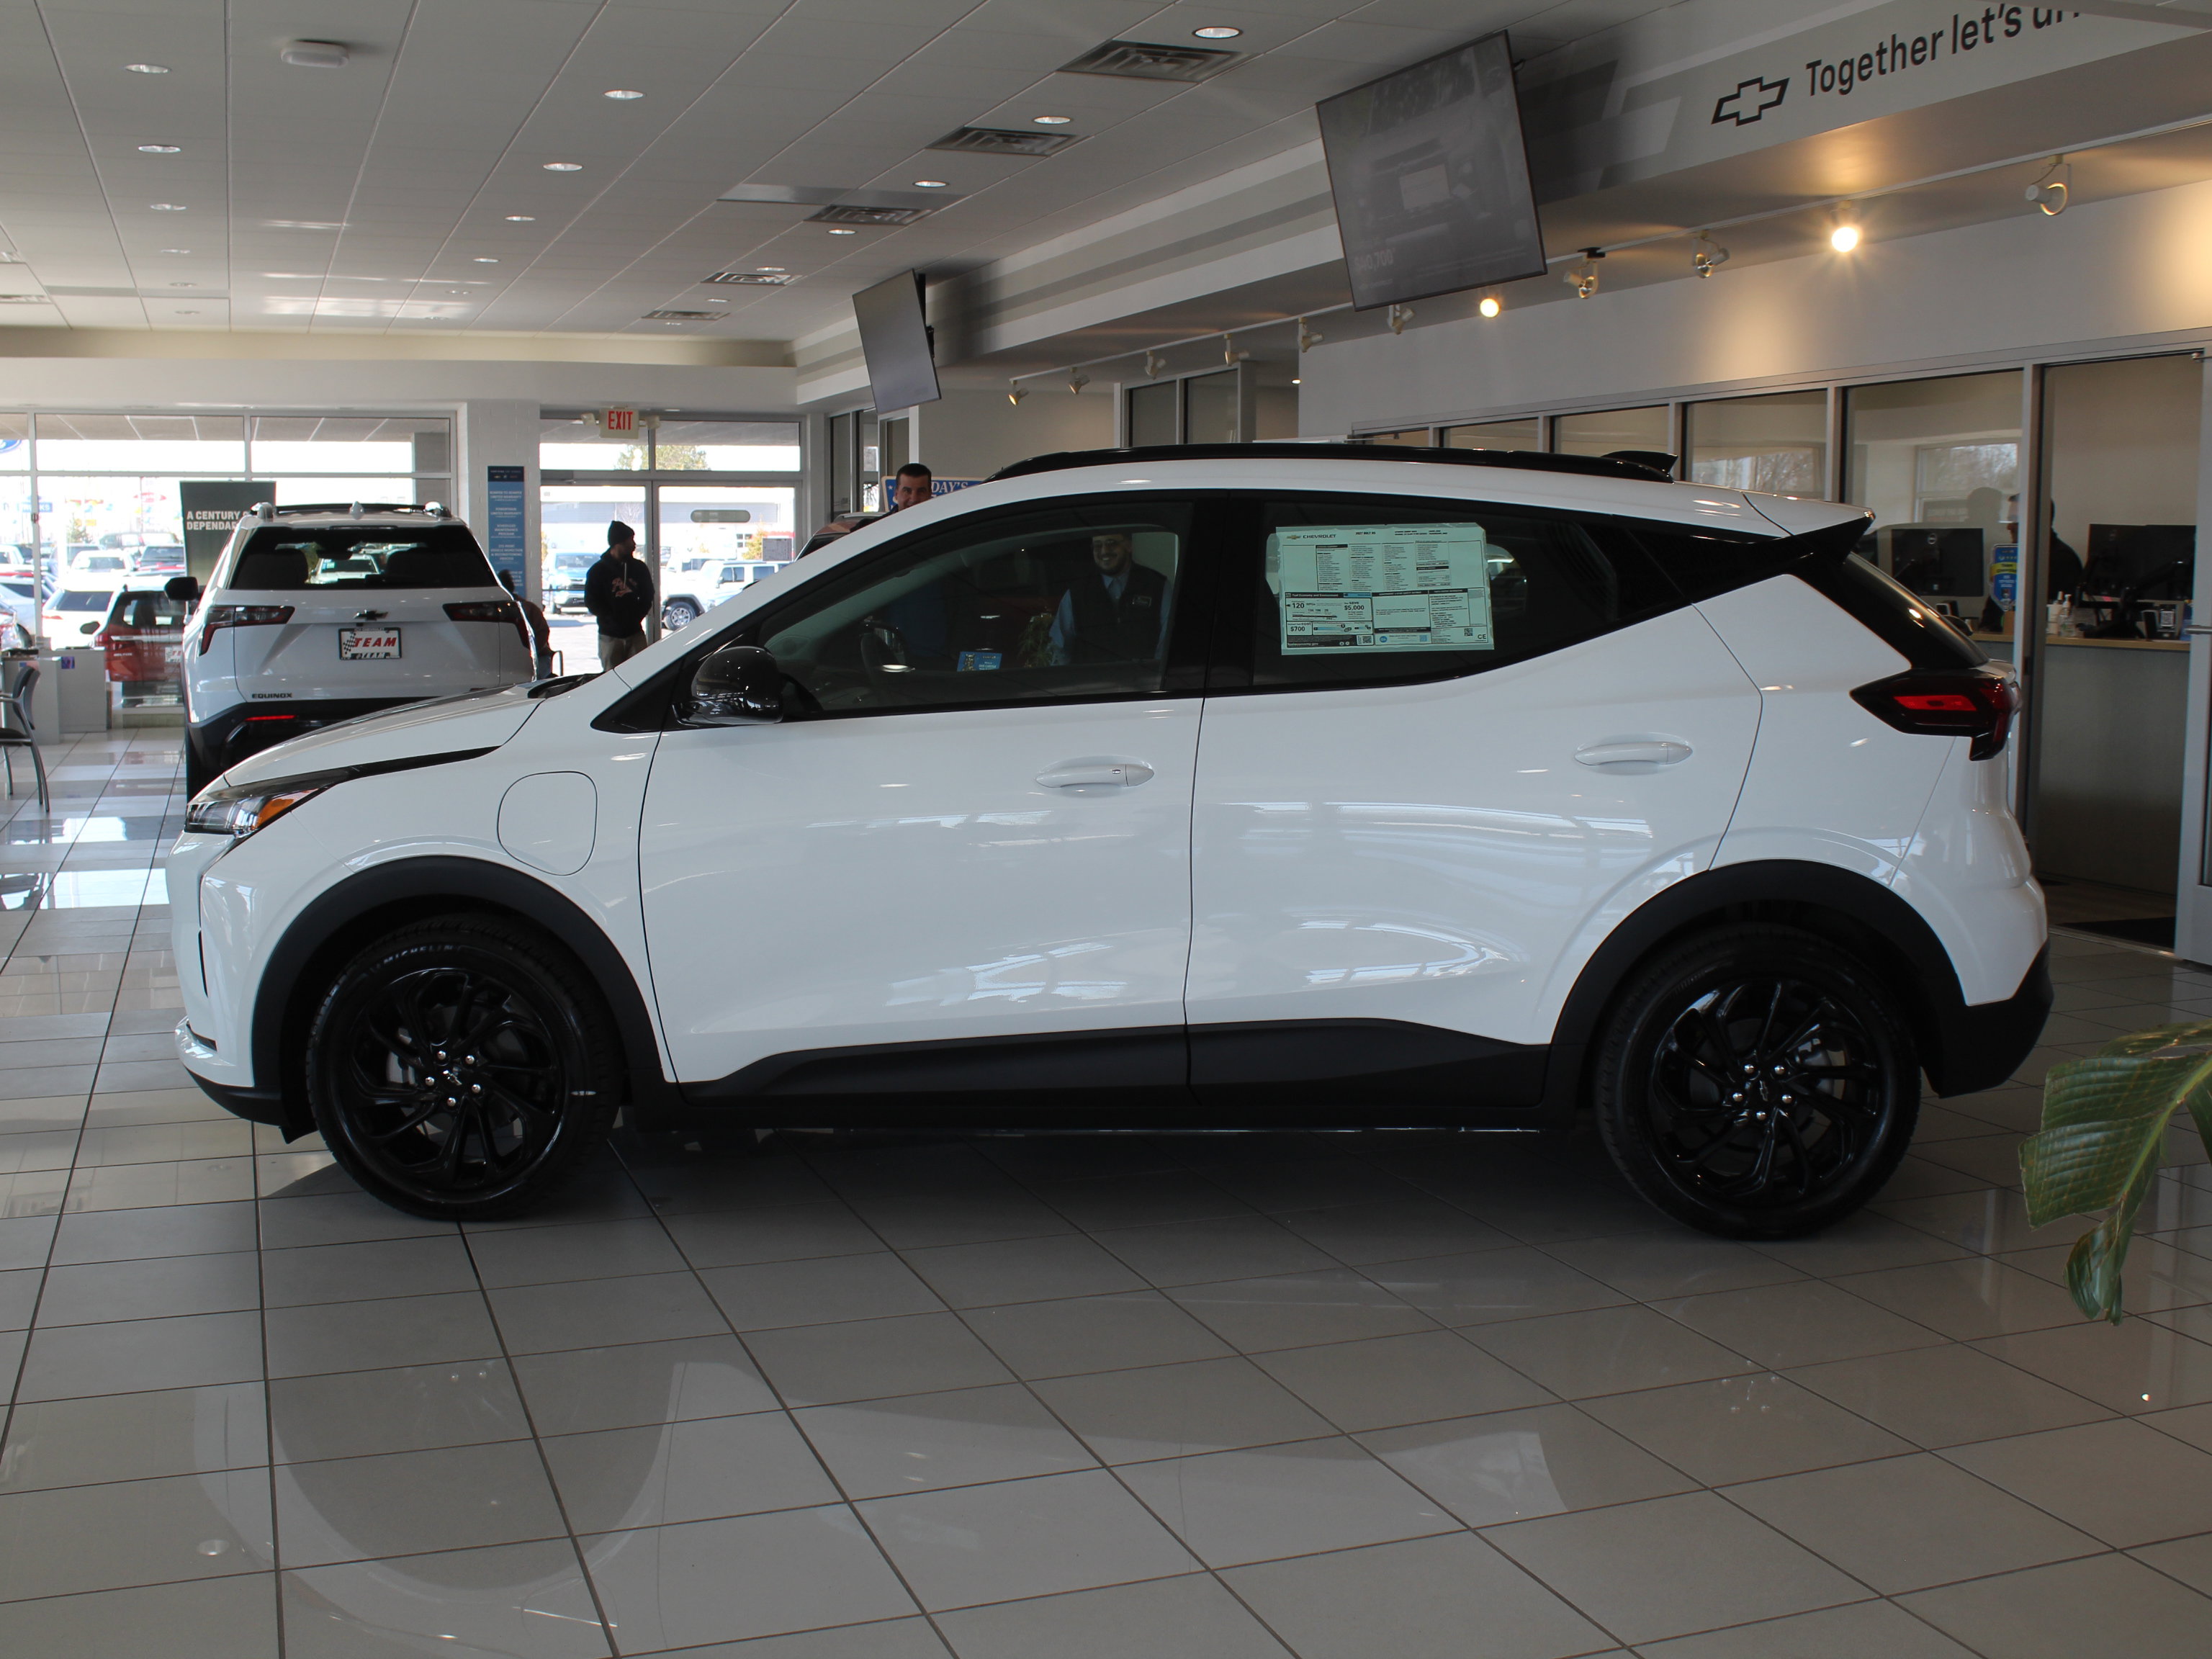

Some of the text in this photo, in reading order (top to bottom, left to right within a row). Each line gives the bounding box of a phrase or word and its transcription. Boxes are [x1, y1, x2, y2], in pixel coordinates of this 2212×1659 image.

[1806, 3, 2022, 96] Together let's
[608, 410, 634, 431] EXIT
[186, 511, 194, 520] A
[195, 511, 240, 520] CENTURY
[353, 637, 397, 647] TEAM
